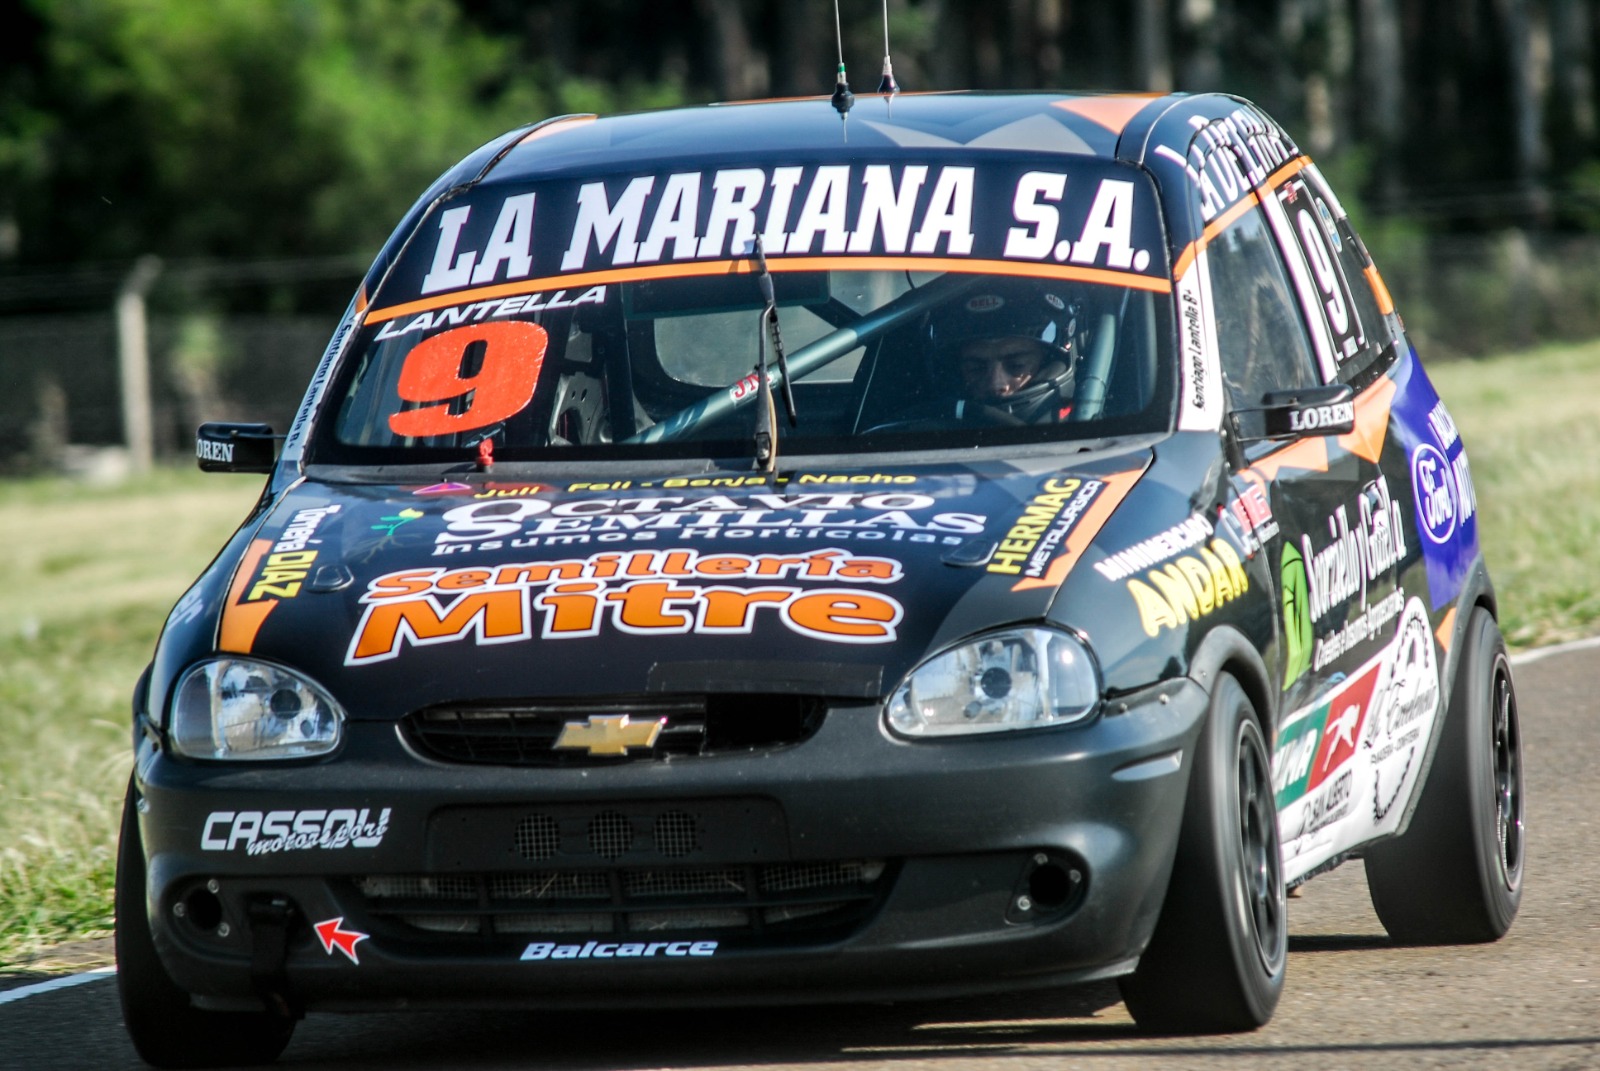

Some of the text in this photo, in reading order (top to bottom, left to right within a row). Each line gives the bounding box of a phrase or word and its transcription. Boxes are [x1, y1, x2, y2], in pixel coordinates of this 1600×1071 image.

[420, 163, 1151, 295] LA MARIANA S.A.
[1298, 208, 1349, 336] 9
[374, 285, 607, 342] LANTELLA
[388, 320, 549, 437] 9
[196, 438, 235, 463] OREN
[442, 493, 936, 521] OCTAVIO
[474, 486, 540, 498] Juli
[567, 480, 632, 492] Feli
[663, 477, 766, 488] Benja
[799, 473, 917, 485] Nacho
[1418, 457, 1453, 530] Ford
[432, 531, 658, 556] Insumos
[434, 509, 987, 543] SEMILLAS
[986, 478, 1082, 575] HERMAG
[1024, 480, 1103, 577] METALURGICA
[1093, 512, 1214, 582] MINIMERCADO
[247, 550, 319, 601] DIAZ
[358, 547, 905, 604] Semillería
[343, 579, 905, 667] Mitre
[246, 822, 390, 856] motorsport
[519, 941, 719, 961] Balcarce
